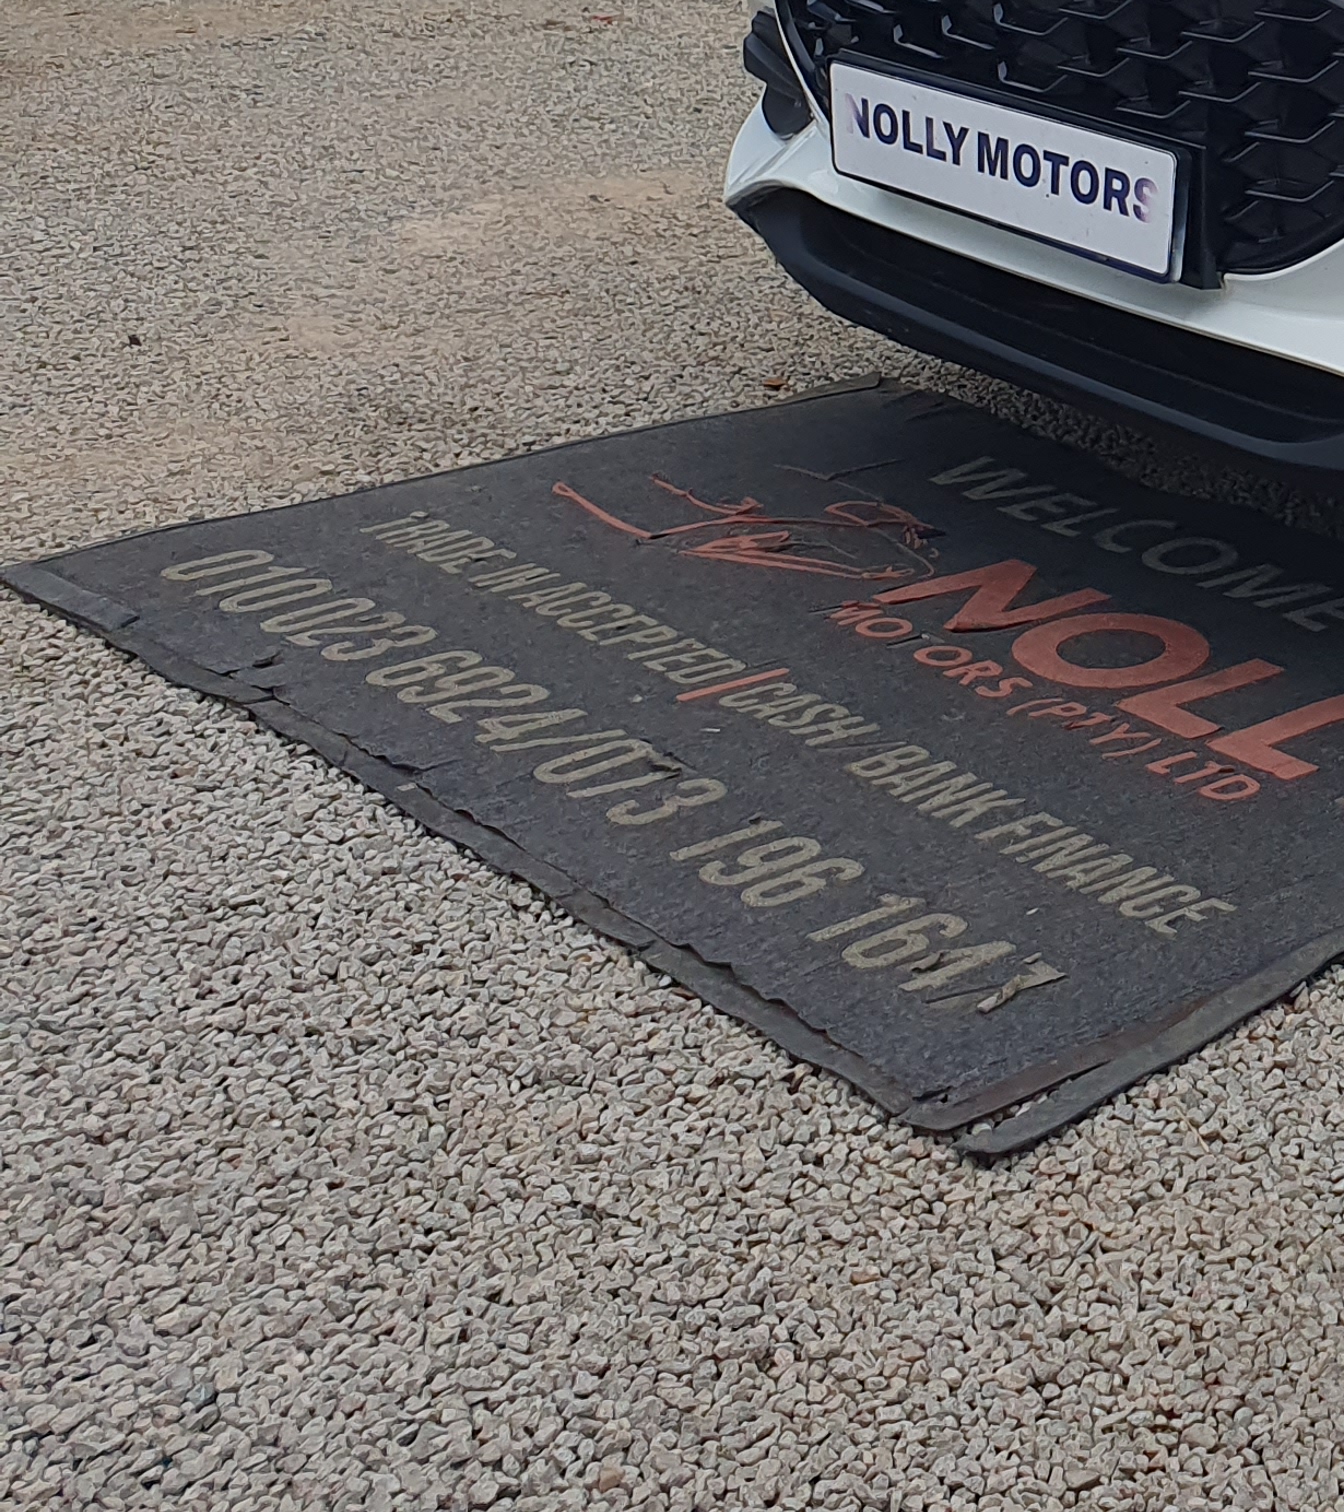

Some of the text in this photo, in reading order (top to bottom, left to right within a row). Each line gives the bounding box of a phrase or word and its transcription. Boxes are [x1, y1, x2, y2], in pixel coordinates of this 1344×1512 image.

[845, 92, 1158, 224] NOLLY MOTORS
[359, 510, 517, 574] TRADE
[468, 562, 561, 593] IN
[975, 811, 1239, 936] FINANCE
[1145, 751, 1261, 801] LTD
[669, 818, 866, 908] 196
